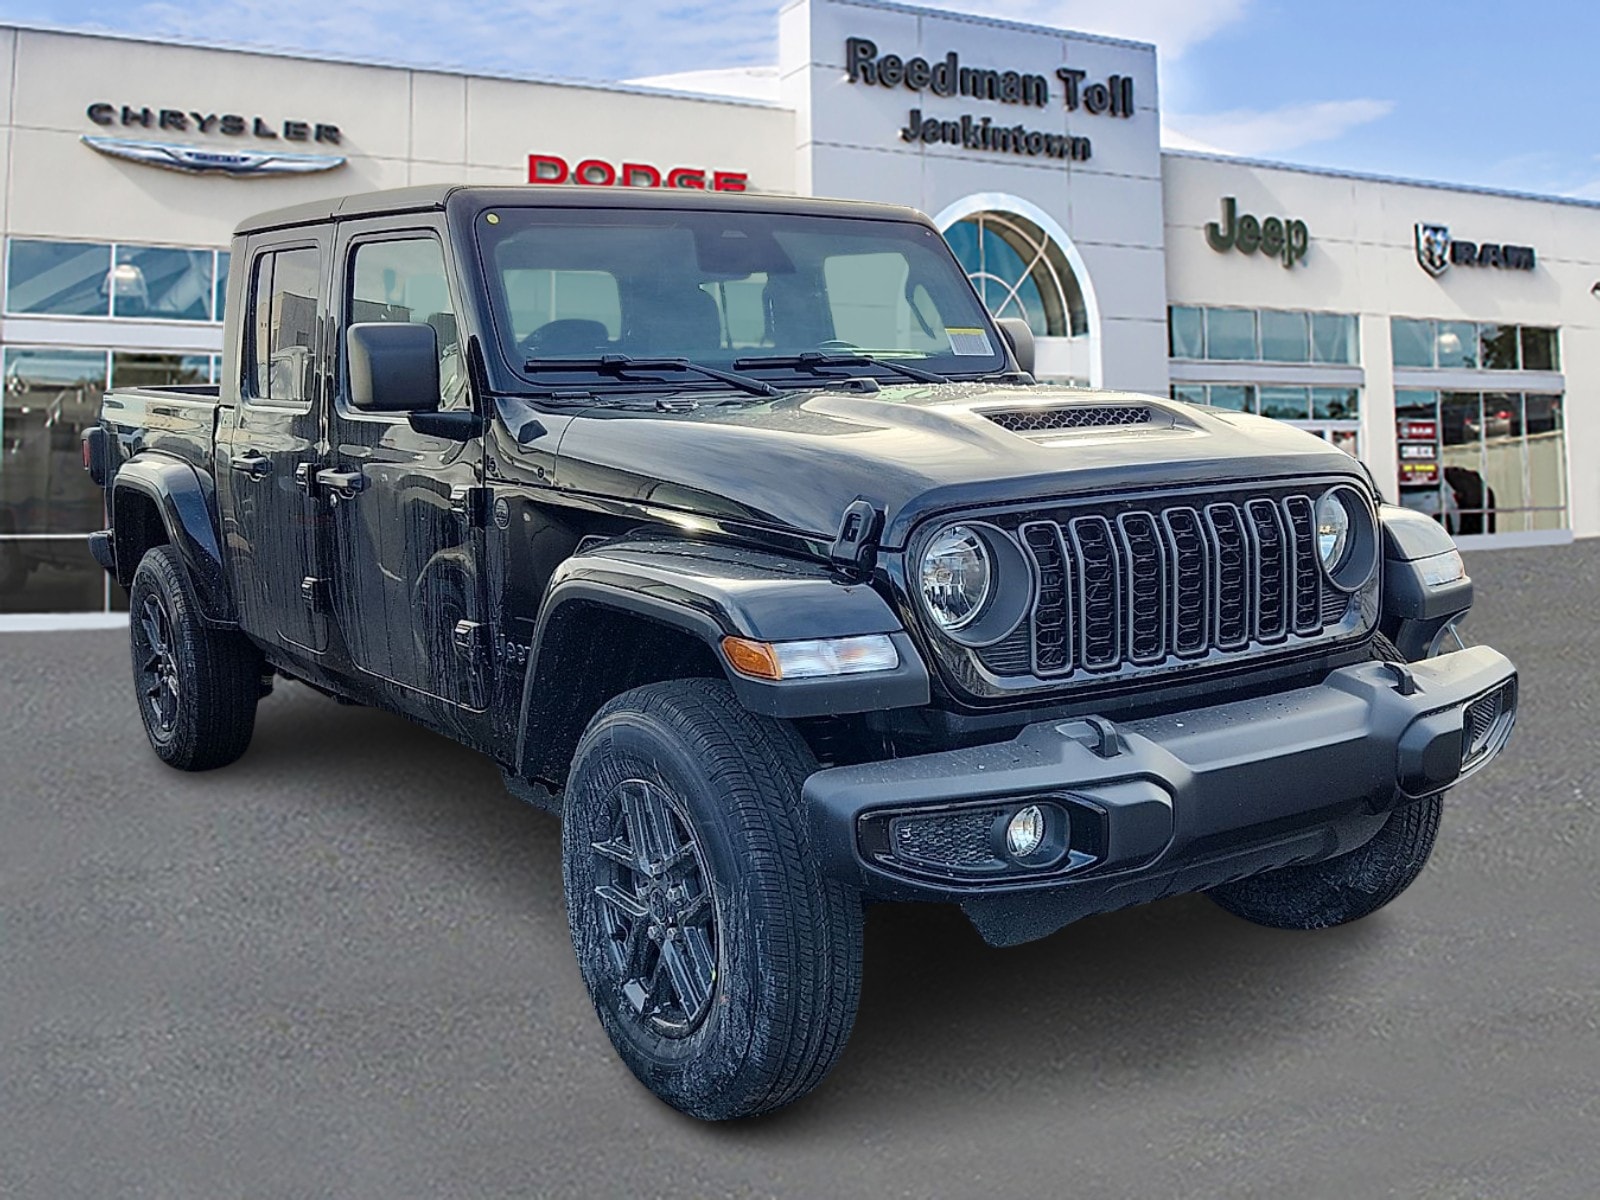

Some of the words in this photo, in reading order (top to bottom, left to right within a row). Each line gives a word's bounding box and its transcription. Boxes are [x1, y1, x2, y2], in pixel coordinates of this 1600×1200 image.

[846, 37, 1048, 107] Reedman
[1057, 66, 1134, 118] Toll
[87, 103, 342, 145] CHRYSLER
[902, 109, 1091, 160] Jenkintown
[528, 154, 748, 192] DODGE
[1204, 196, 1308, 269] Jeep
[1450, 241, 1536, 270] RAM
